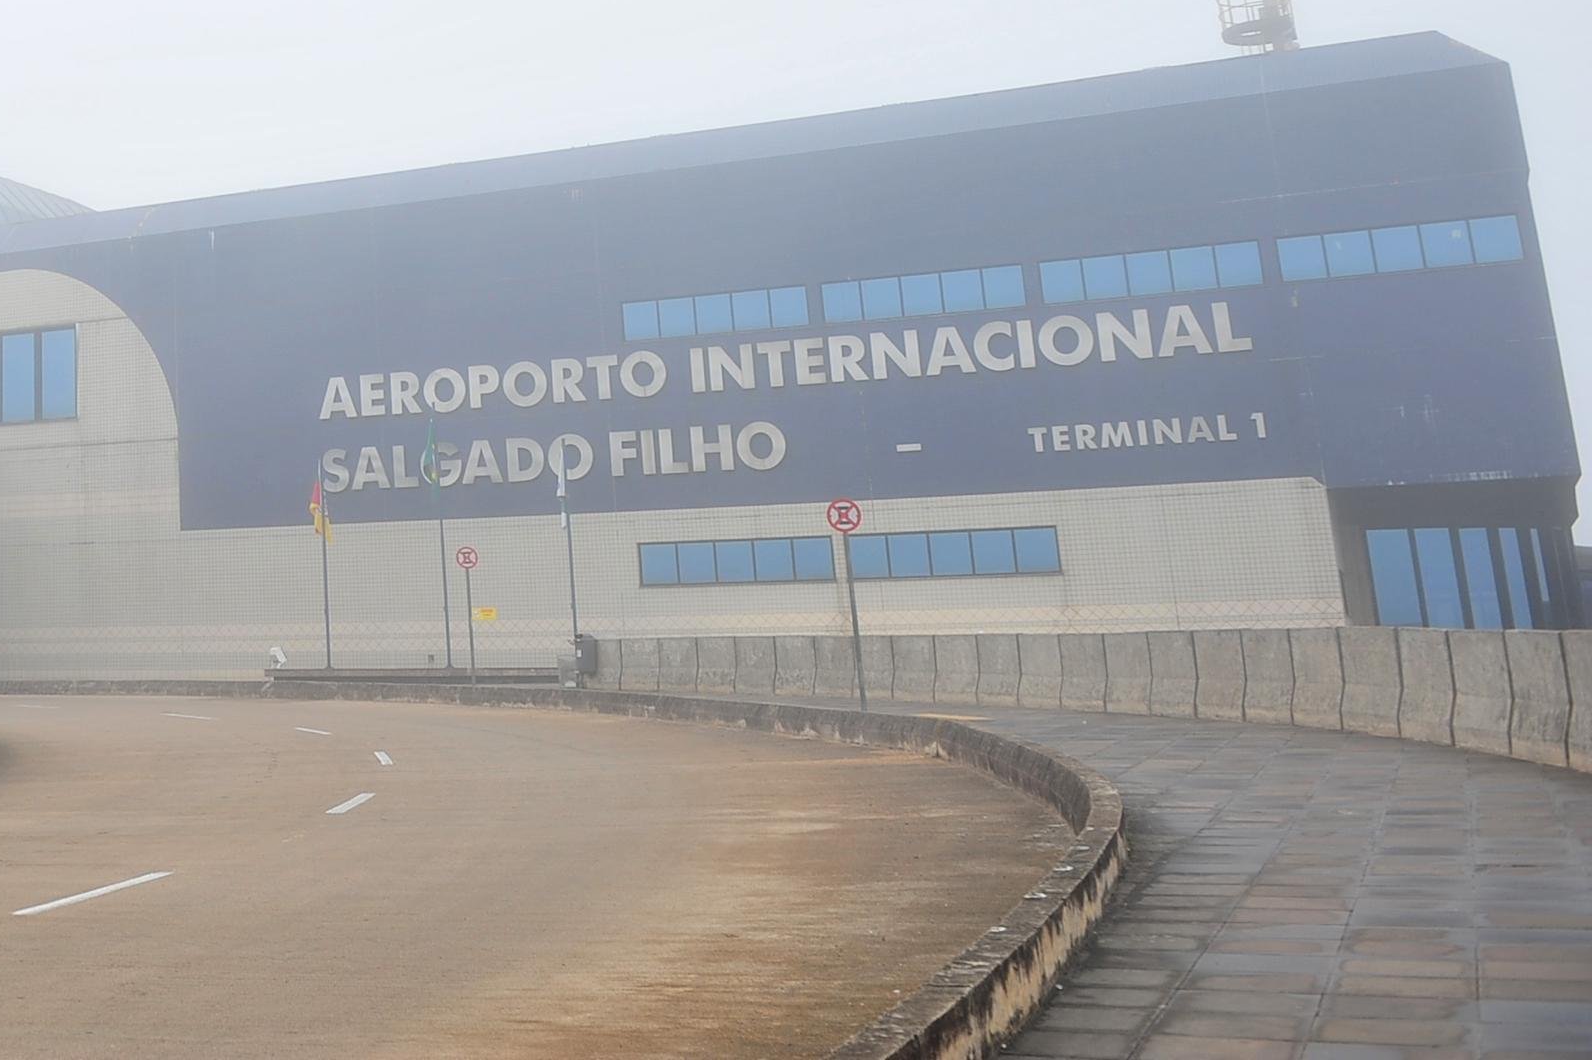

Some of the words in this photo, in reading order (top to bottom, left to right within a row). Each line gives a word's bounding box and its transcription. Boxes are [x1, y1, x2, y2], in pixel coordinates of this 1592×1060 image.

[319, 350, 667, 420] AEROPORTO
[690, 301, 1253, 393] INTERNACIONAL
[321, 433, 594, 493] SALGADO
[609, 421, 787, 477] FILHO
[1028, 414, 1238, 453] TERMINAL
[1250, 411, 1268, 440] 1
